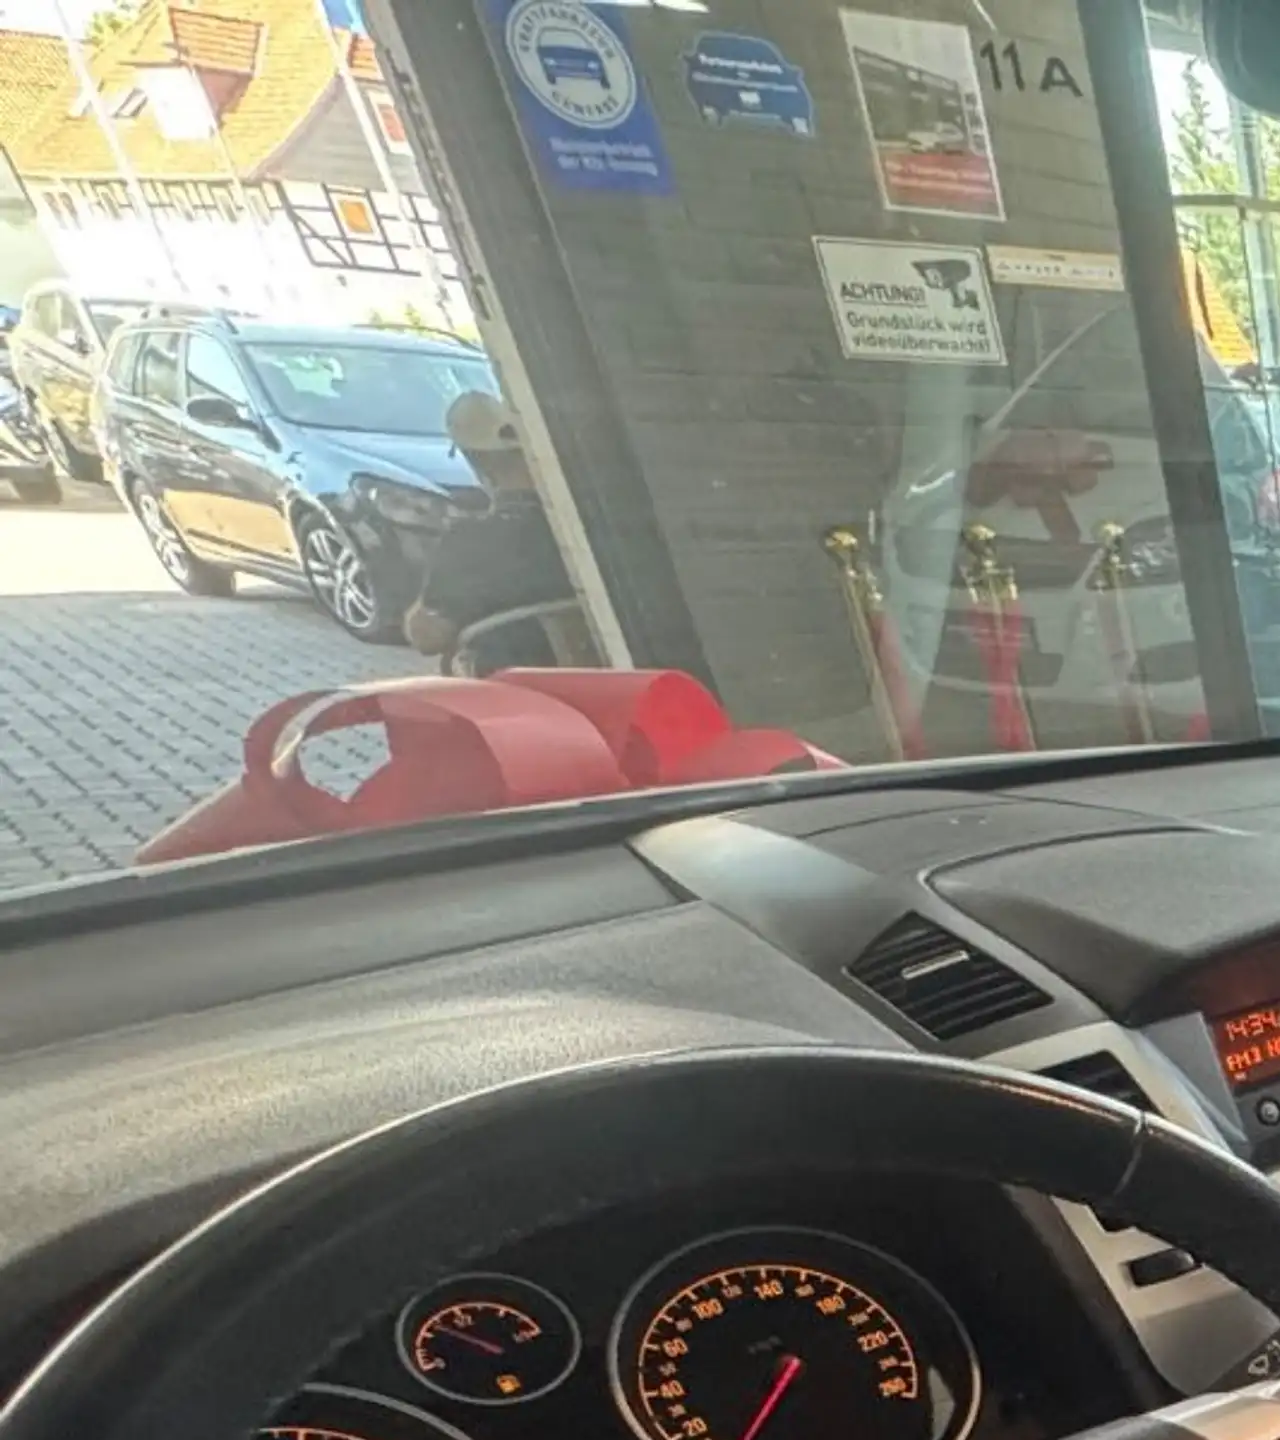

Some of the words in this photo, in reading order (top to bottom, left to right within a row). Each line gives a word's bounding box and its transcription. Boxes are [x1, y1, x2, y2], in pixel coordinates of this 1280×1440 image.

[979, 40, 1025, 92] 11
[1039, 55, 1084, 98] A
[840, 281, 926, 302] ACHTUNG!
[846, 310, 945, 333] Grundstück
[752, 1278, 785, 1301] 140
[691, 1297, 724, 1321] 100
[662, 1336, 689, 1359] 60
[857, 1330, 889, 1353] 220
[660, 1379, 687, 1399] 40
[682, 1416, 709, 1438] 20
